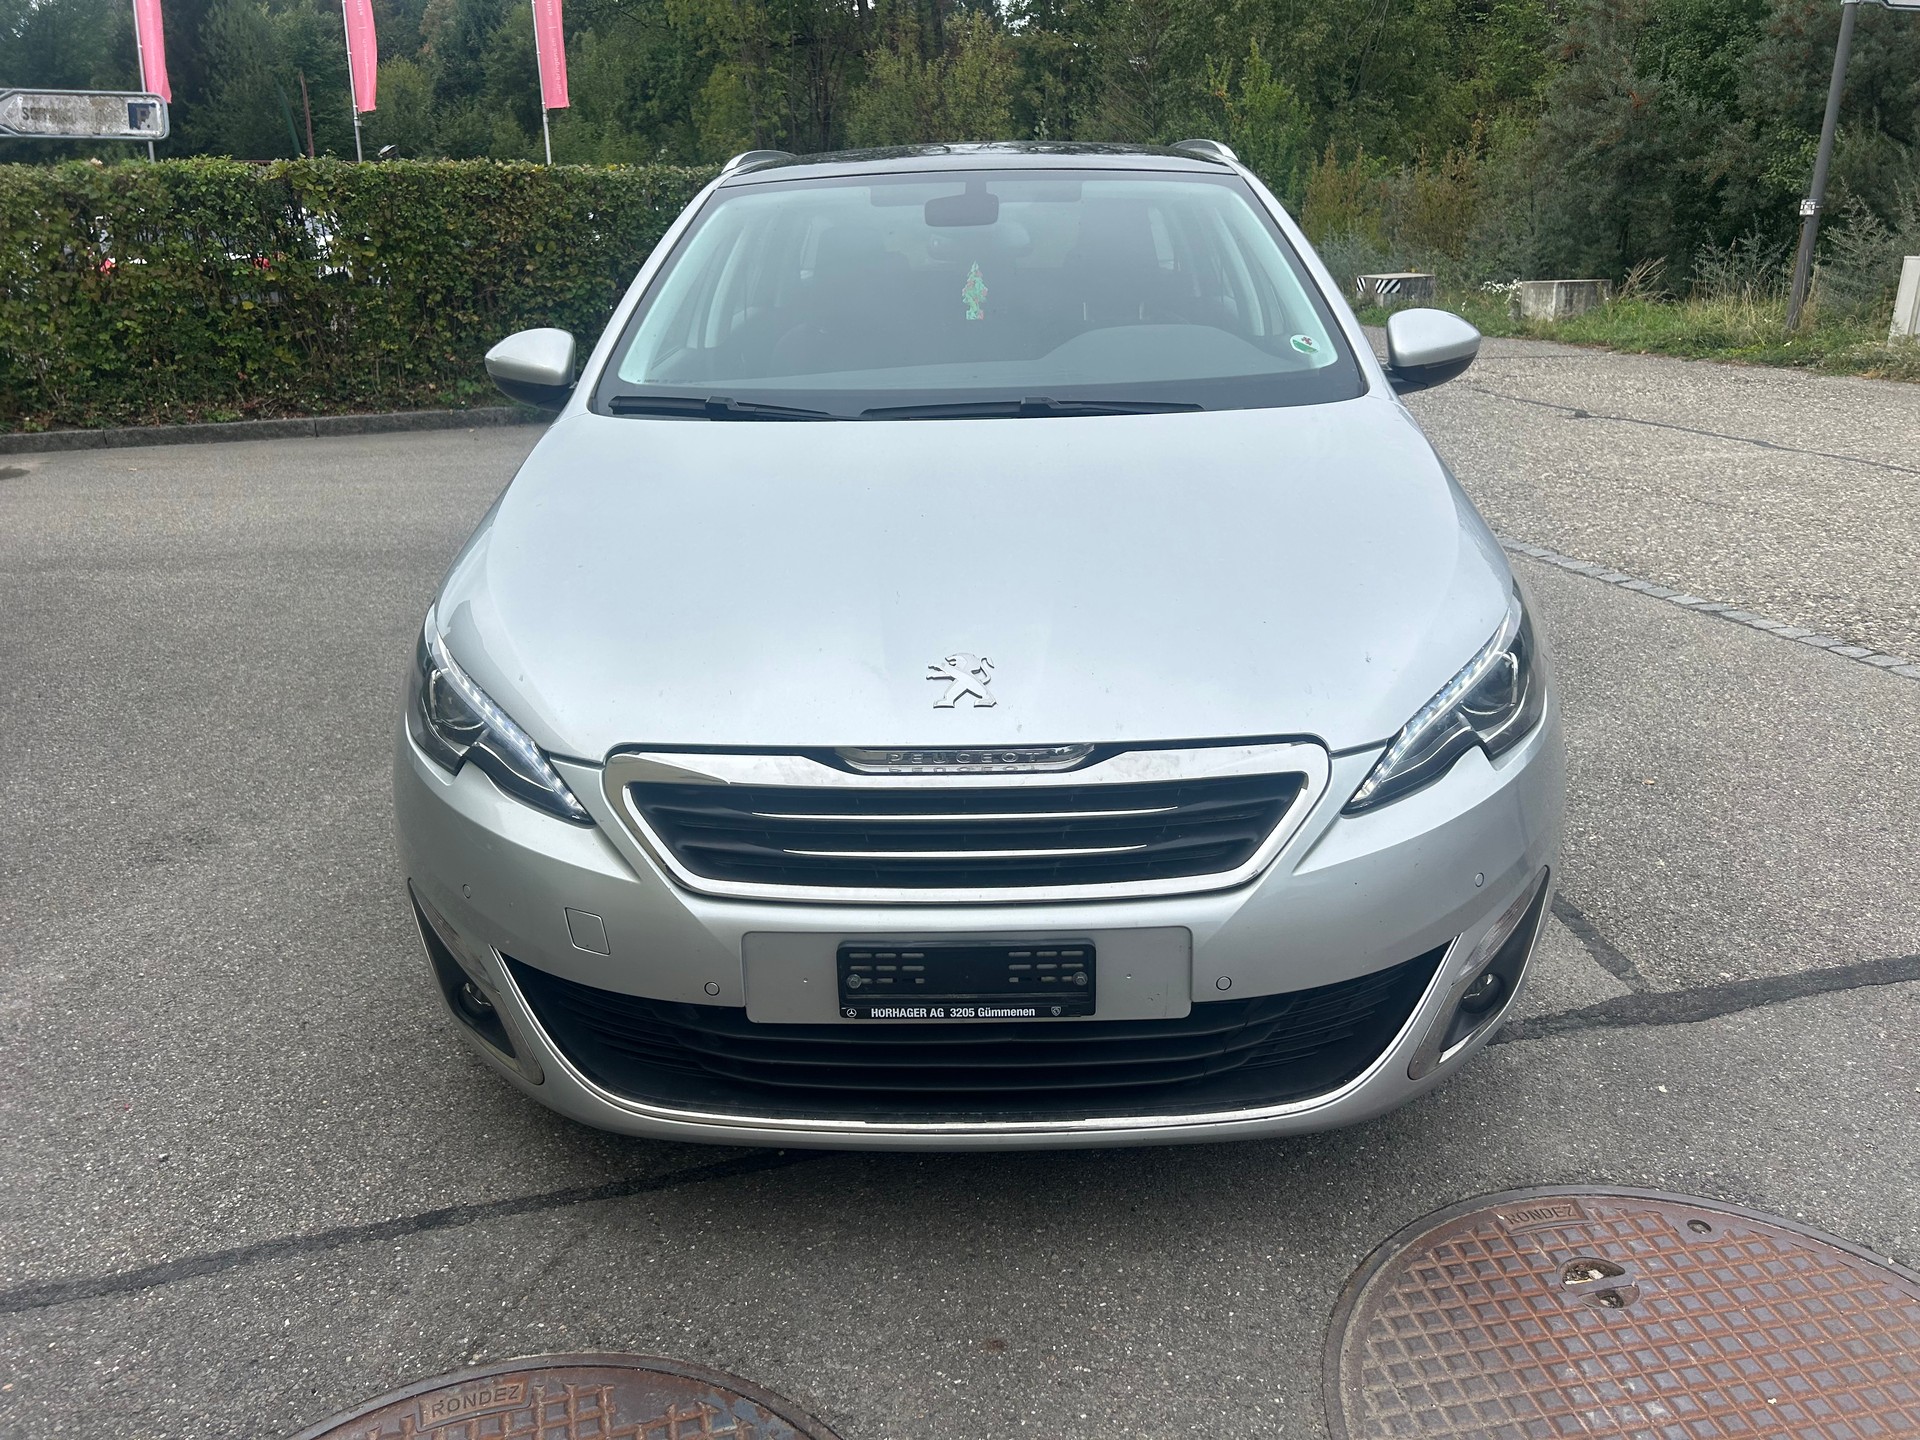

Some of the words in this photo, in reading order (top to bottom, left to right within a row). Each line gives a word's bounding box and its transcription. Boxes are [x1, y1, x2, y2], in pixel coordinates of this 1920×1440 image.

[887, 752, 1040, 764] PEUGEOT
[929, 1007, 945, 1018] AG
[949, 1007, 975, 1018] 3205
[977, 1006, 1036, 1017] Gümmenen
[1504, 1204, 1577, 1225] RONDEZ
[431, 1385, 520, 1418] RONDEZ
